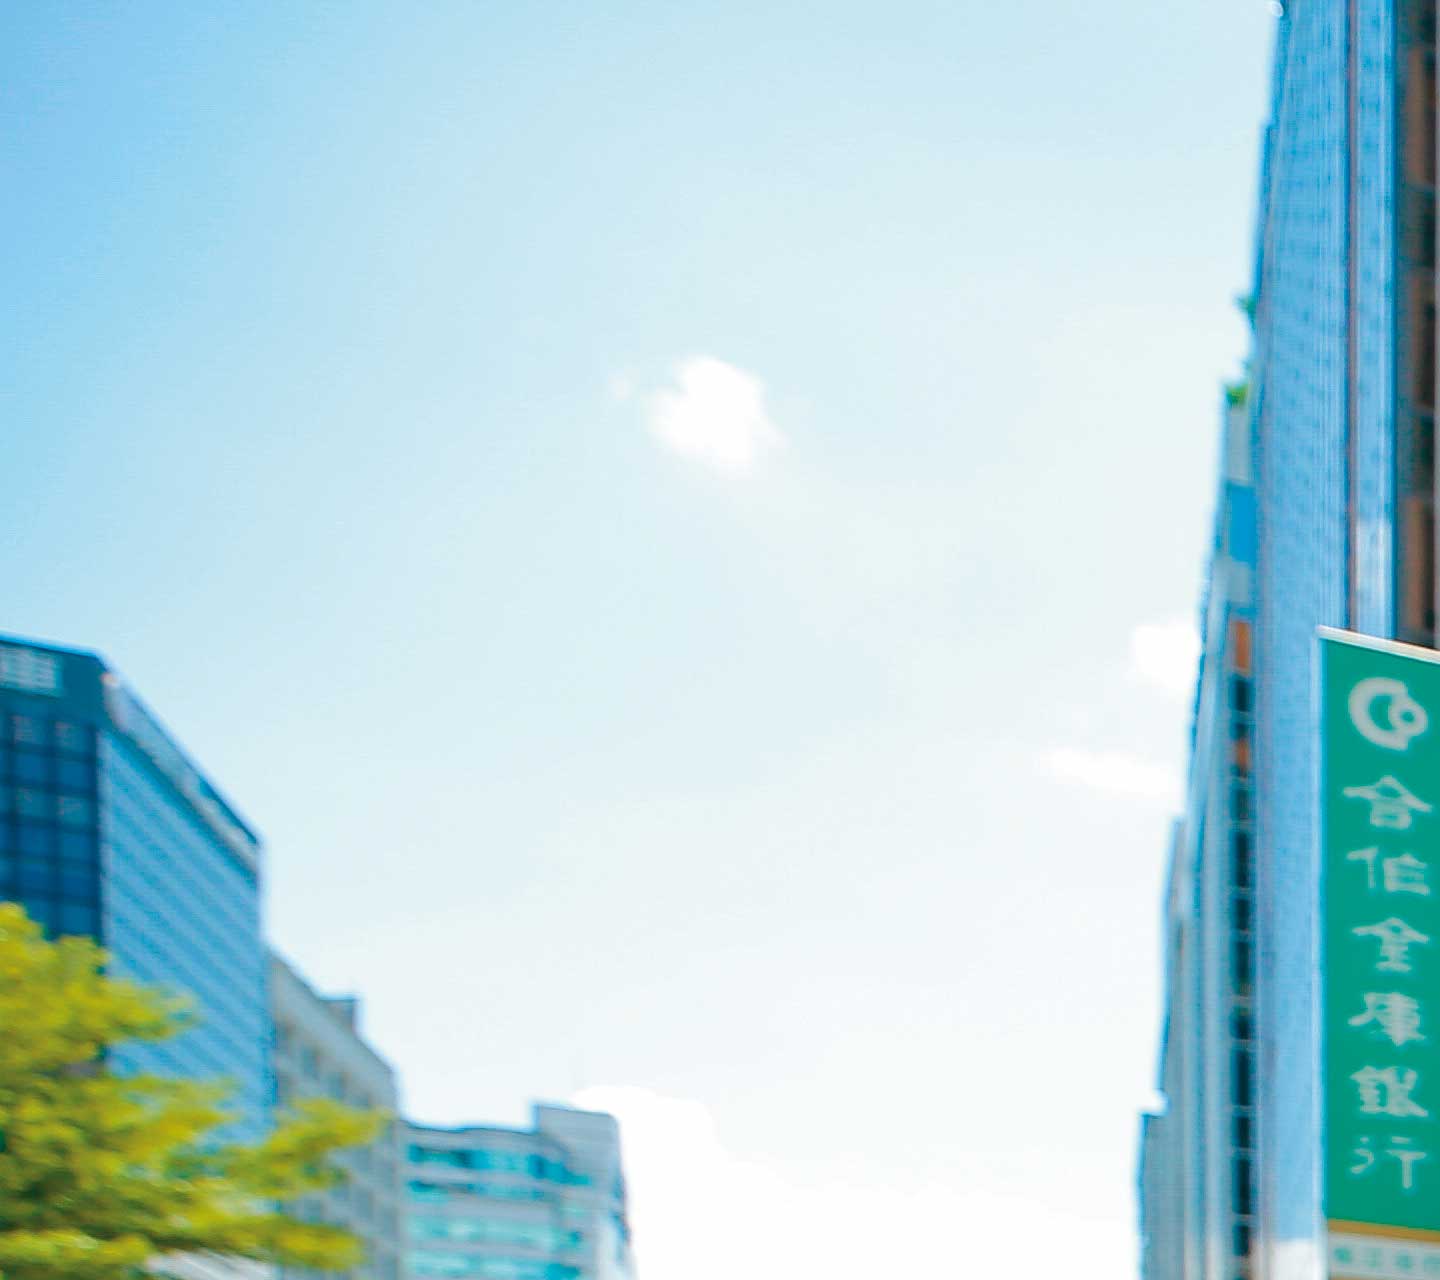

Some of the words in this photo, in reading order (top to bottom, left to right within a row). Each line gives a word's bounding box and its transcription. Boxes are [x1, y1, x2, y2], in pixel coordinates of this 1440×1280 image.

[1343, 775, 1433, 1191] 合作金庫銀行
